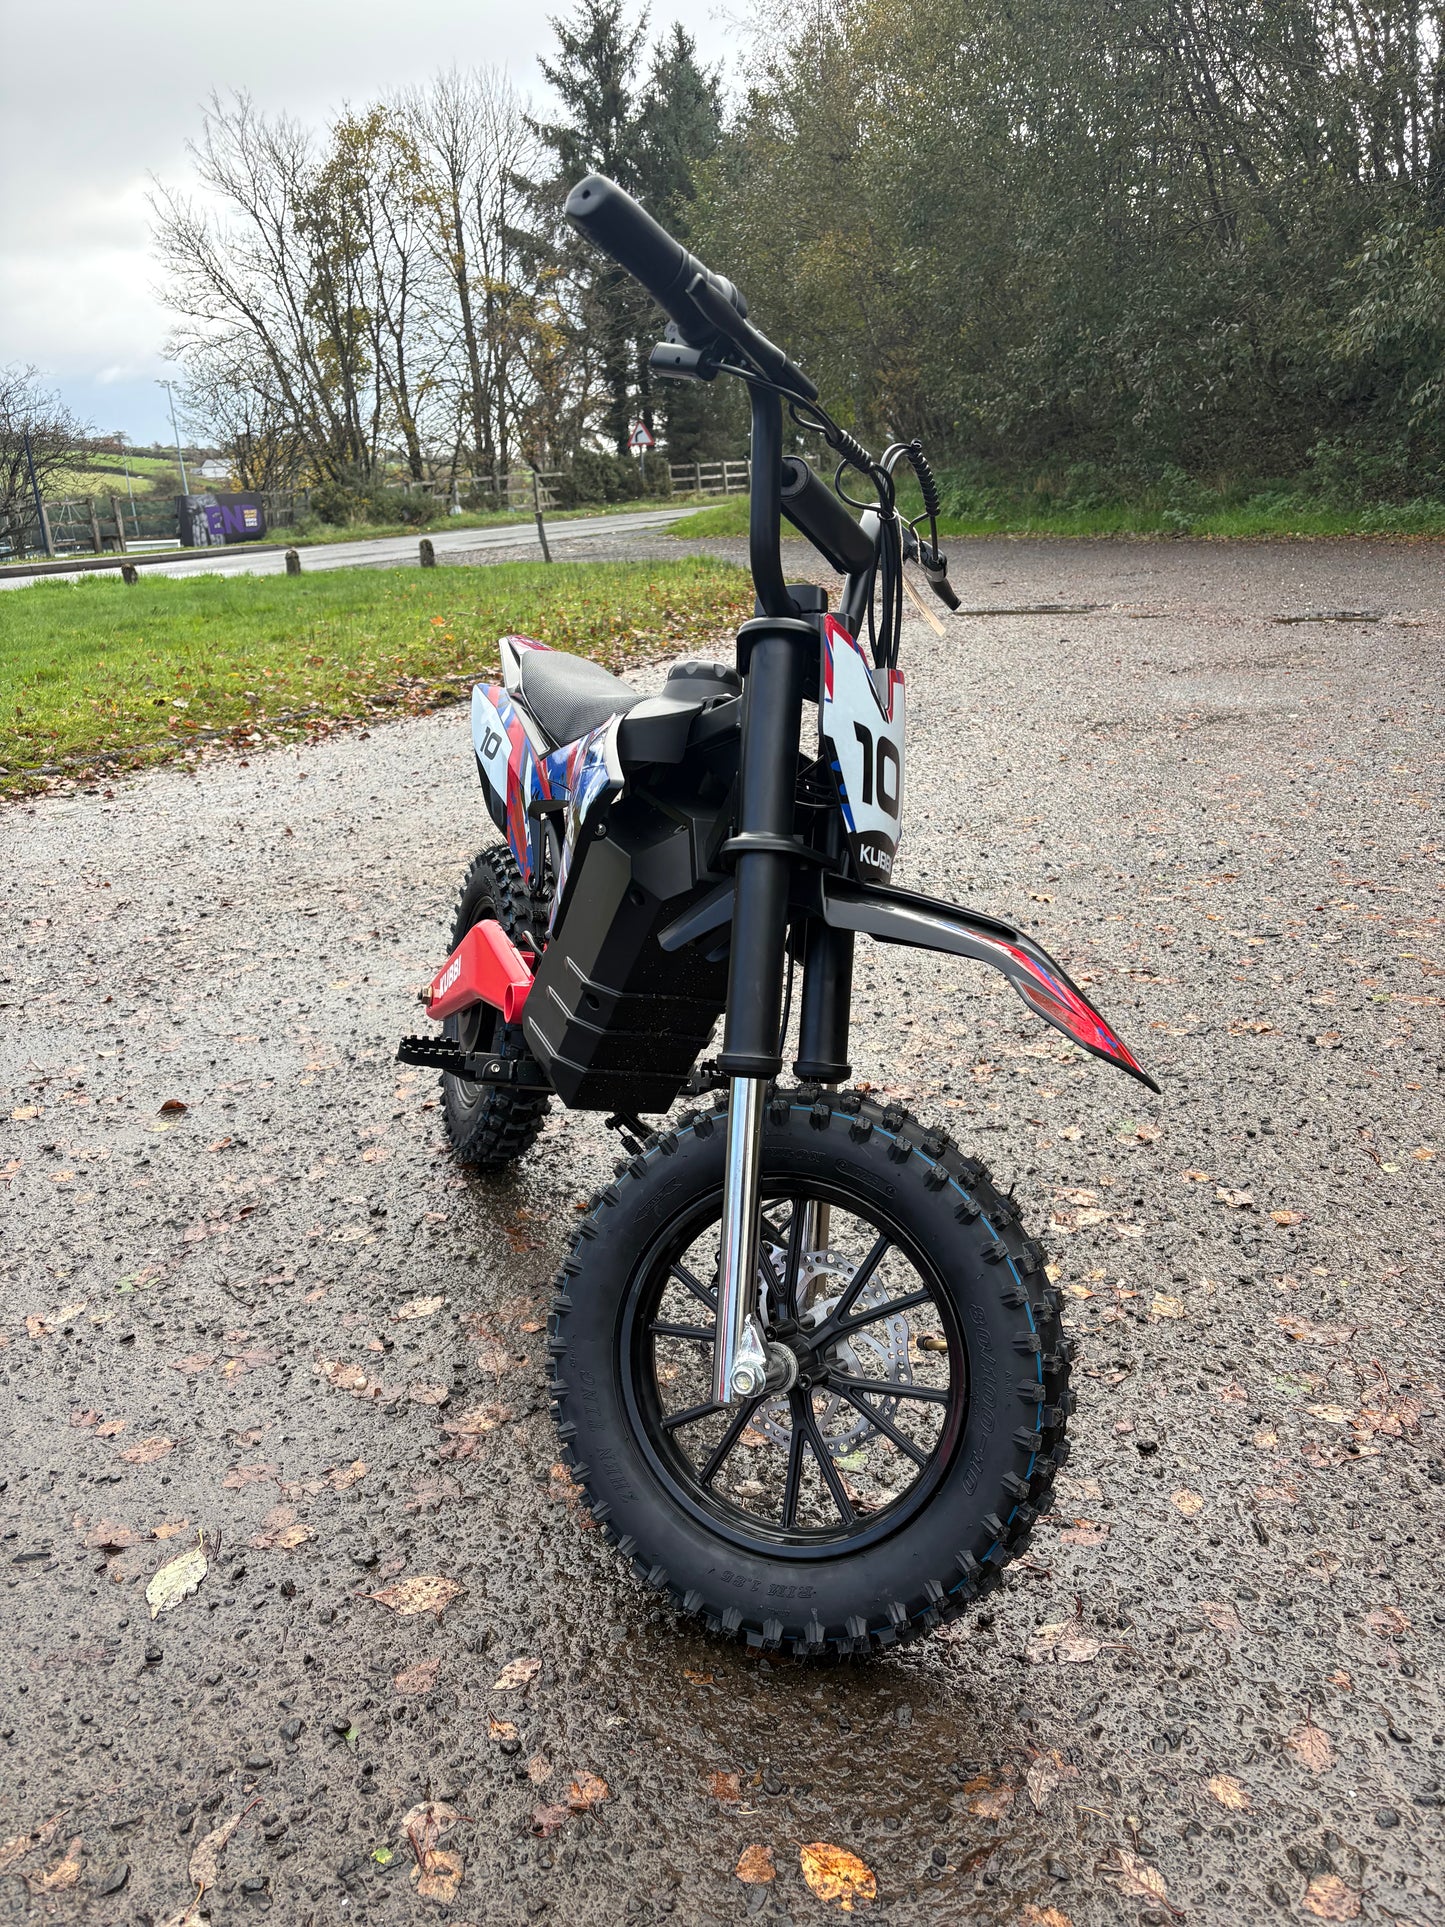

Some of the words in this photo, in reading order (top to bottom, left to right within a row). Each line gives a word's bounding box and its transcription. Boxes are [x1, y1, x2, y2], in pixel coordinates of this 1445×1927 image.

[205, 504, 262, 535] END
[480, 726, 502, 760] 10
[853, 721, 900, 821] 10
[859, 843, 892, 875] KUBB
